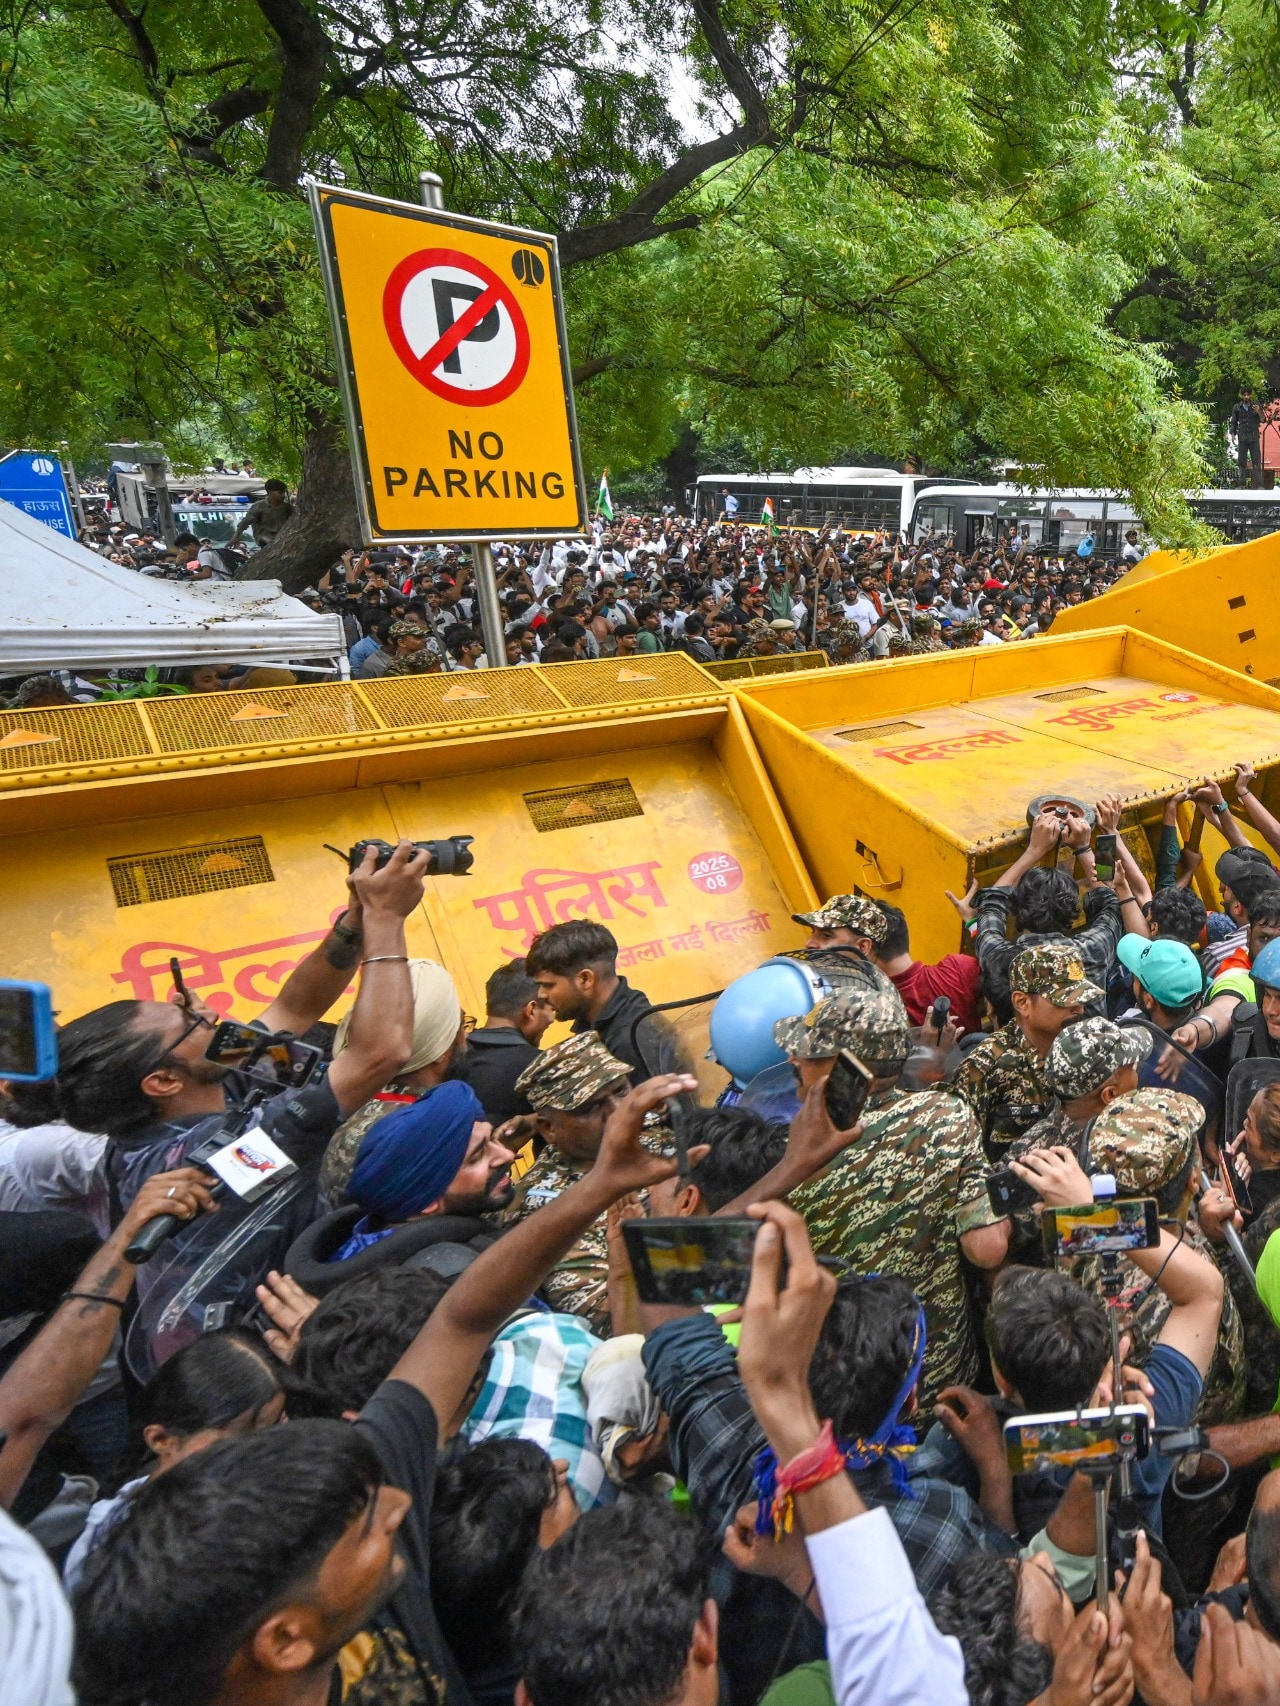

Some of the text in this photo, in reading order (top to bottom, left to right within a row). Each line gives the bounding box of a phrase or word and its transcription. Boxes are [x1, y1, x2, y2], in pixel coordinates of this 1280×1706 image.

[447, 429, 504, 460] NO
[383, 466, 565, 499] PARKING
[22, 501, 60, 512] हाऊस
[178, 511, 224, 522] DELHI
[40, 519, 65, 529] USE
[1044, 697, 1164, 732] पुलिस
[874, 728, 1024, 766] दिल्ली
[691, 855, 729, 875] 2025
[706, 874, 727, 889] 08
[472, 860, 668, 959] पुलिस
[667, 924, 705, 951] नई
[705, 909, 772, 943] दिल्ली
